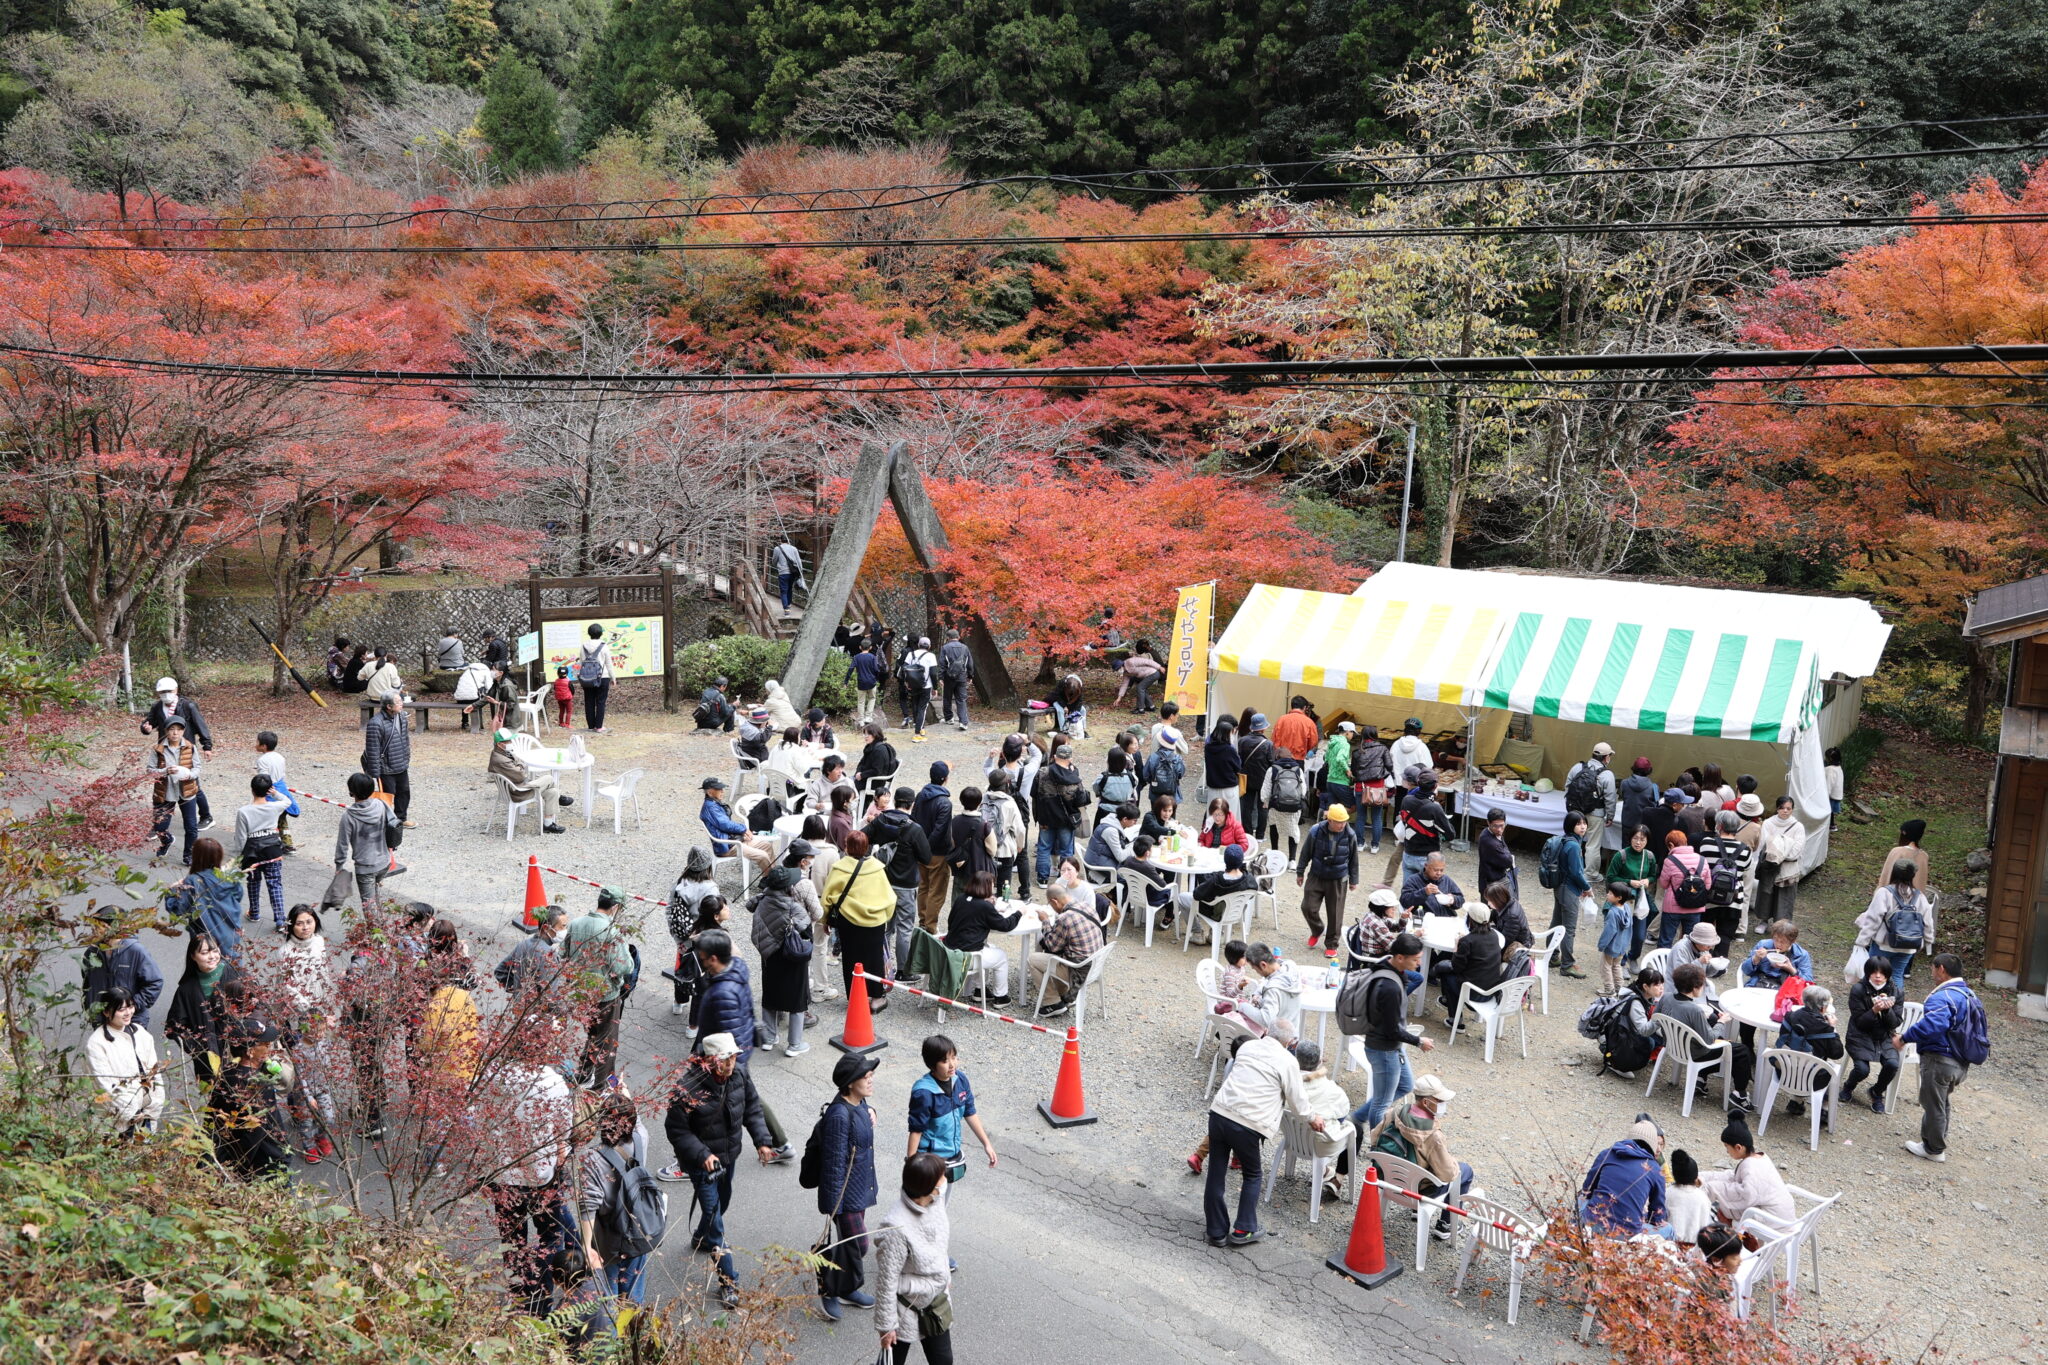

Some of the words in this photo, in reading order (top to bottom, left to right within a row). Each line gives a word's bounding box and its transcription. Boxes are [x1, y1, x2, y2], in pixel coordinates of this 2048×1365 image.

[1178, 597, 1198, 686] せとやコロッケ
